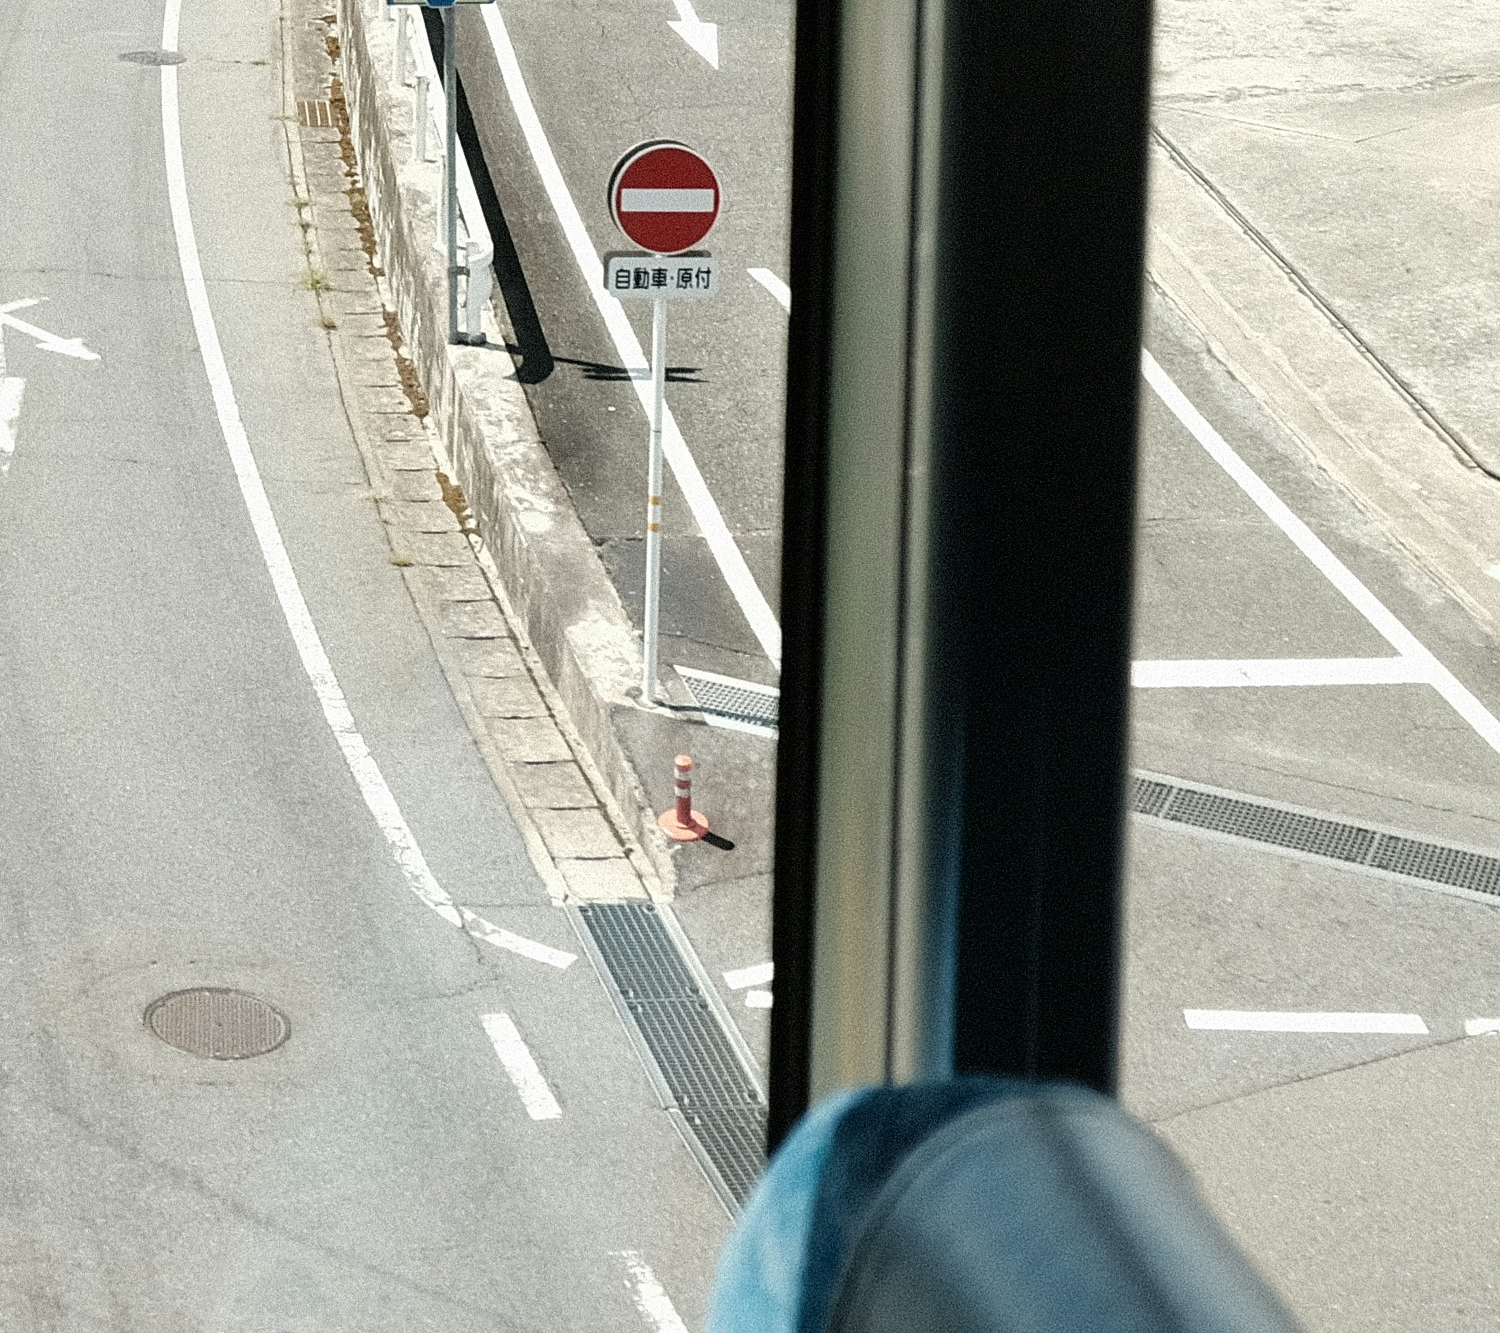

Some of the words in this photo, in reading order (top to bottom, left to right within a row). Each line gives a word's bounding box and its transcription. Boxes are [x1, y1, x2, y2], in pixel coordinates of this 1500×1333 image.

[615, 268, 711, 290] 自動車・原付
